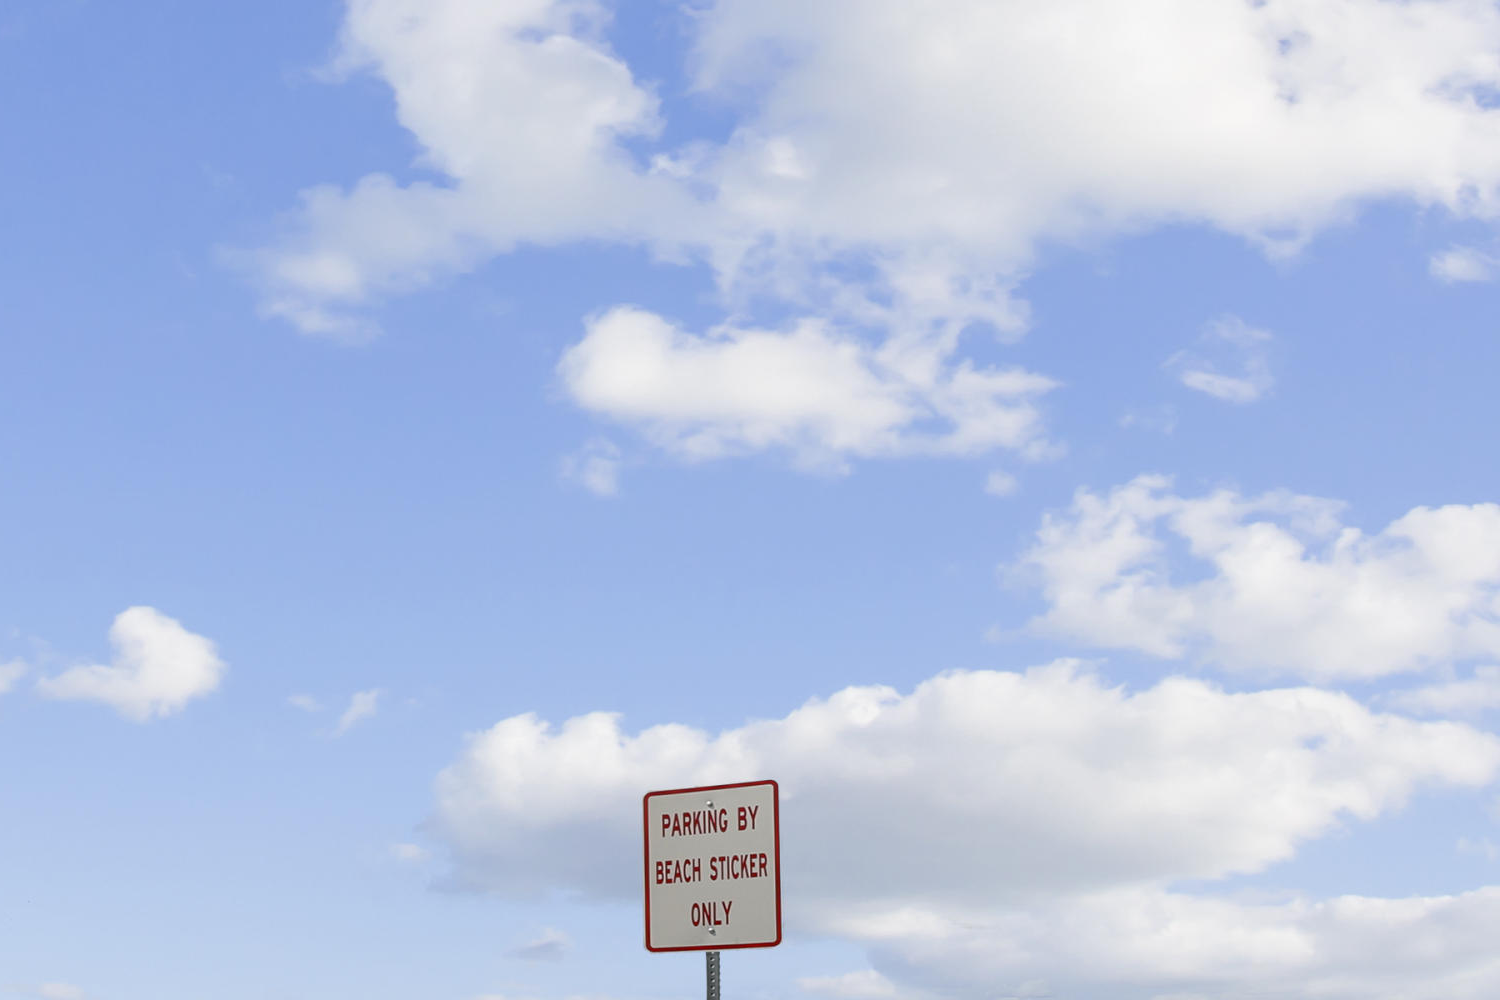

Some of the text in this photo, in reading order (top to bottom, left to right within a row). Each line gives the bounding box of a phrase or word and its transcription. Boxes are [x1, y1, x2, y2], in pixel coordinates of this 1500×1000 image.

[662, 805, 759, 837] PARKING BY
[656, 853, 768, 884] BEACH STICKER
[691, 901, 732, 927] ONLY
